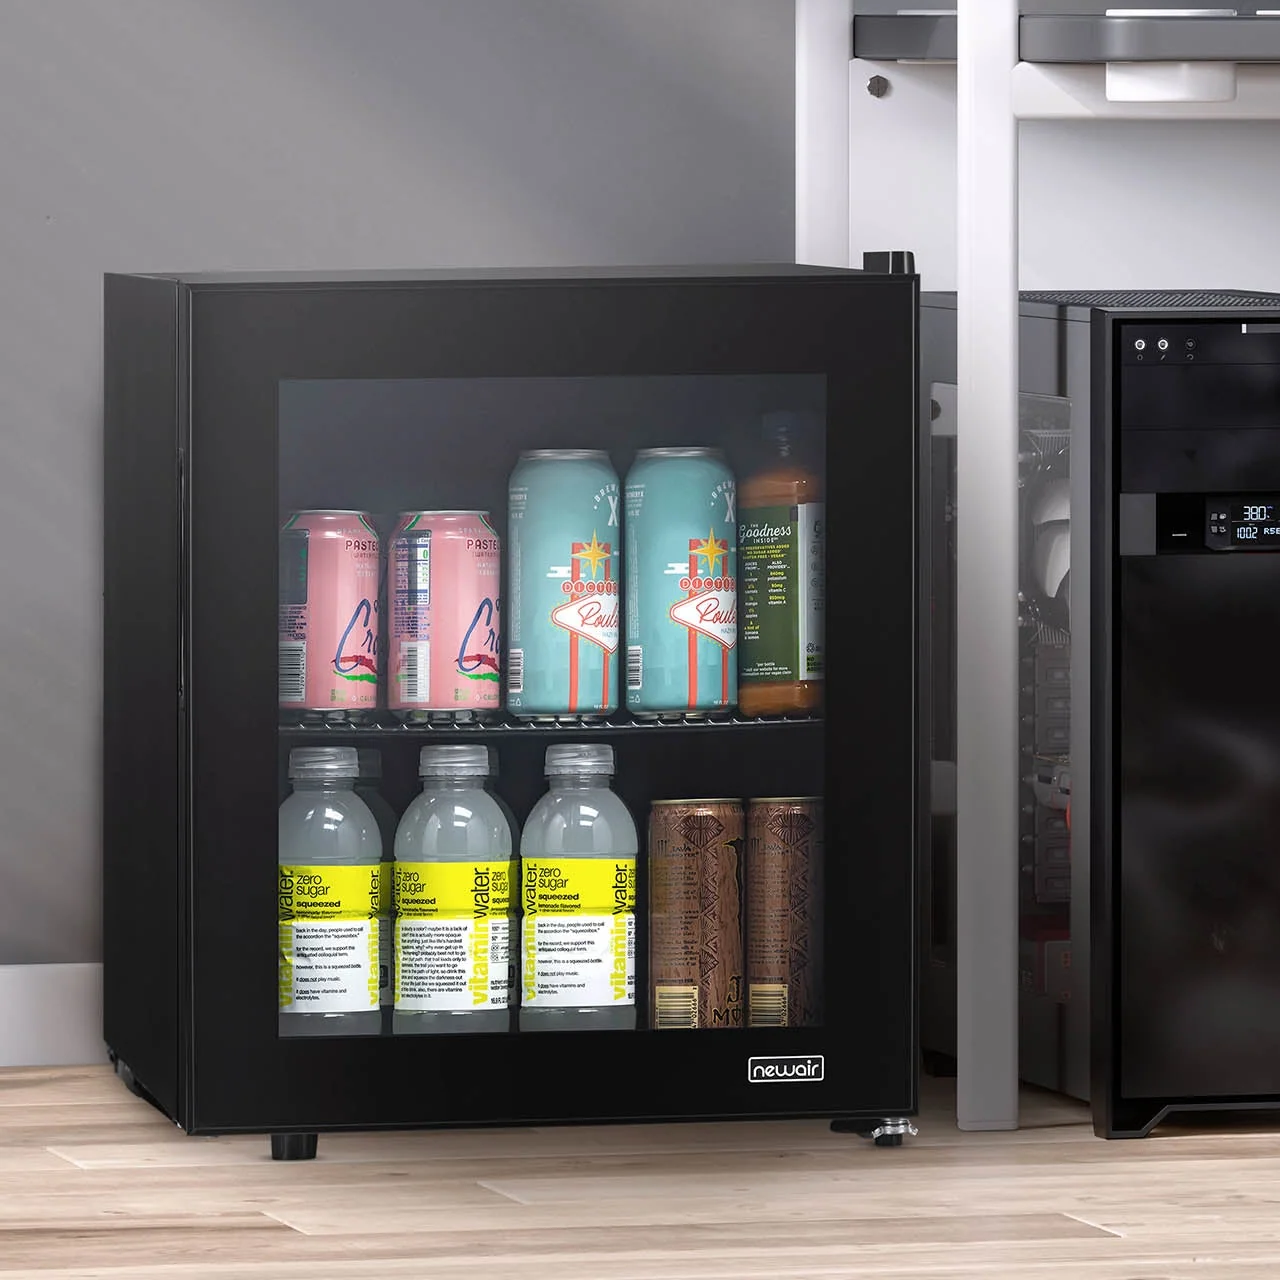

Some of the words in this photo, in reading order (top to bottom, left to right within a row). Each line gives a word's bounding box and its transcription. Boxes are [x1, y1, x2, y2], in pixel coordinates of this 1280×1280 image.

[739, 523, 792, 543] Goodness
[296, 874, 322, 884] zero
[402, 872, 420, 882] zero
[538, 868, 562, 878] zero
[296, 885, 330, 898] sugar
[402, 882, 426, 896] sugar
[525, 864, 538, 916] water.
[538, 878, 568, 890] sugar
[612, 864, 628, 915] water.
[368, 870, 380, 920] water.
[470, 867, 490, 919] water.
[538, 893, 580, 901] squeezed
[296, 900, 340, 908] squeezed
[468, 919, 488, 1005] vitamin
[610, 915, 626, 1000] vitamin
[754, 1060, 820, 1078] newair
